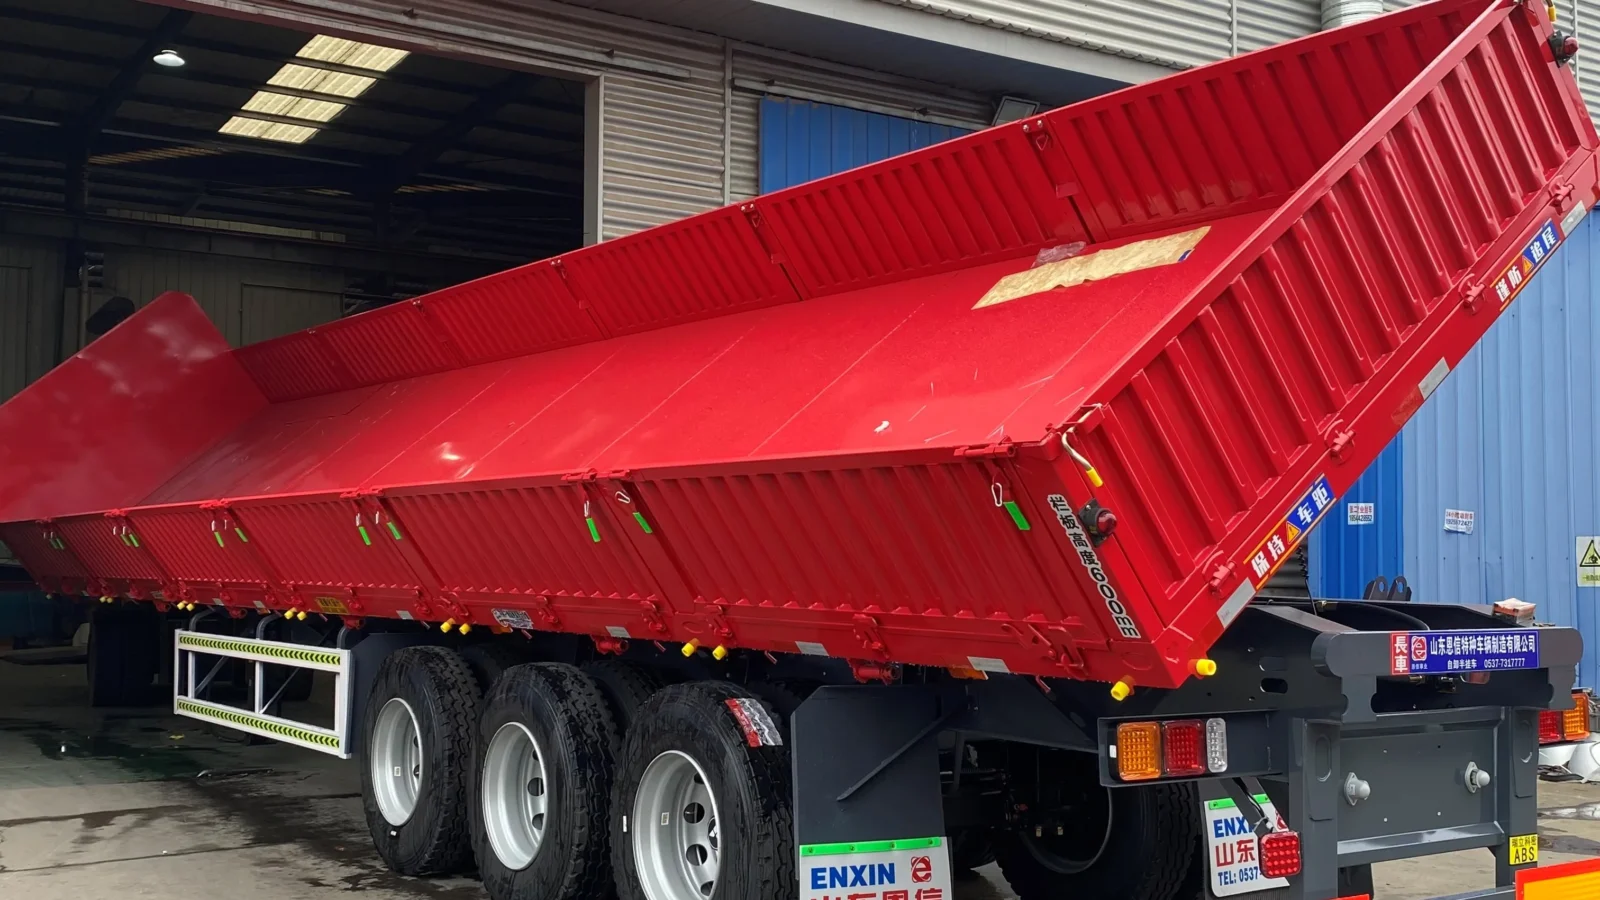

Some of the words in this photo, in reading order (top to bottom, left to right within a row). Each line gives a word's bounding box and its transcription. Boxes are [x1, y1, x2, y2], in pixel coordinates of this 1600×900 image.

[1495, 265, 1522, 302] 谨防
[1529, 226, 1556, 263] 追尾
[1251, 534, 1286, 579] 保持
[1296, 482, 1330, 526] 车距
[1394, 635, 1408, 672] 長車
[1430, 634, 1536, 656] 山东恩信特种车辆制造有限公司
[1447, 659, 1477, 670] 自卸半挂车
[1483, 657, 1526, 669] 0537-7317777
[1215, 839, 1256, 867] 山东
[1514, 847, 1535, 864] ABS
[811, 862, 896, 890] ENXIN
[1218, 871, 1237, 886] TEL:
